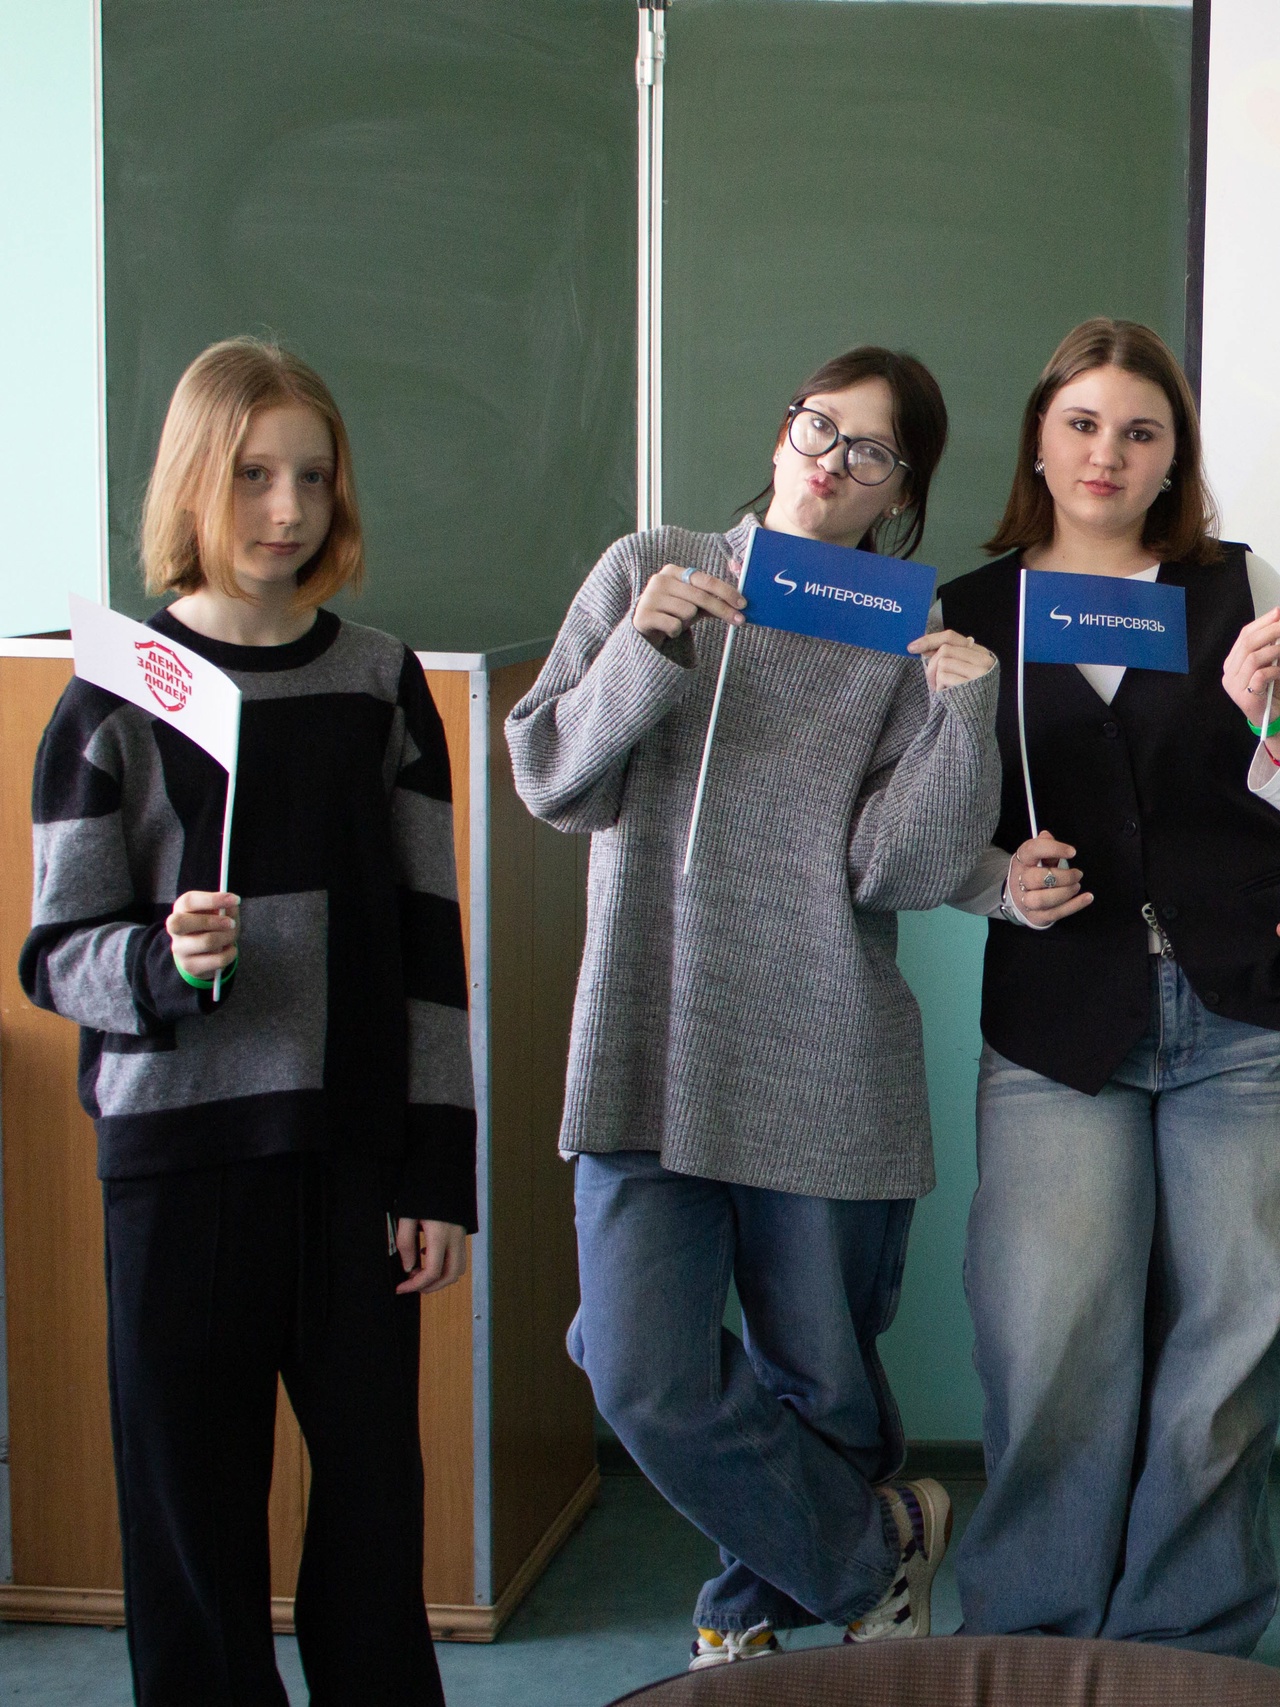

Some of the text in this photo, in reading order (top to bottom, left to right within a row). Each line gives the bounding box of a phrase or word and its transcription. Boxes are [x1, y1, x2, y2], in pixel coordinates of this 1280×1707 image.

[804, 581, 902, 614] ИНТЕРСВЯЗЬ
[1079, 613, 1166, 633] ИНТЕРСВЯЗЬ
[136, 656, 193, 696] ЗАЩИТЫ
[148, 650, 183, 677] ДЕНЬ
[144, 673, 187, 705] ЛЮДЕЙ
